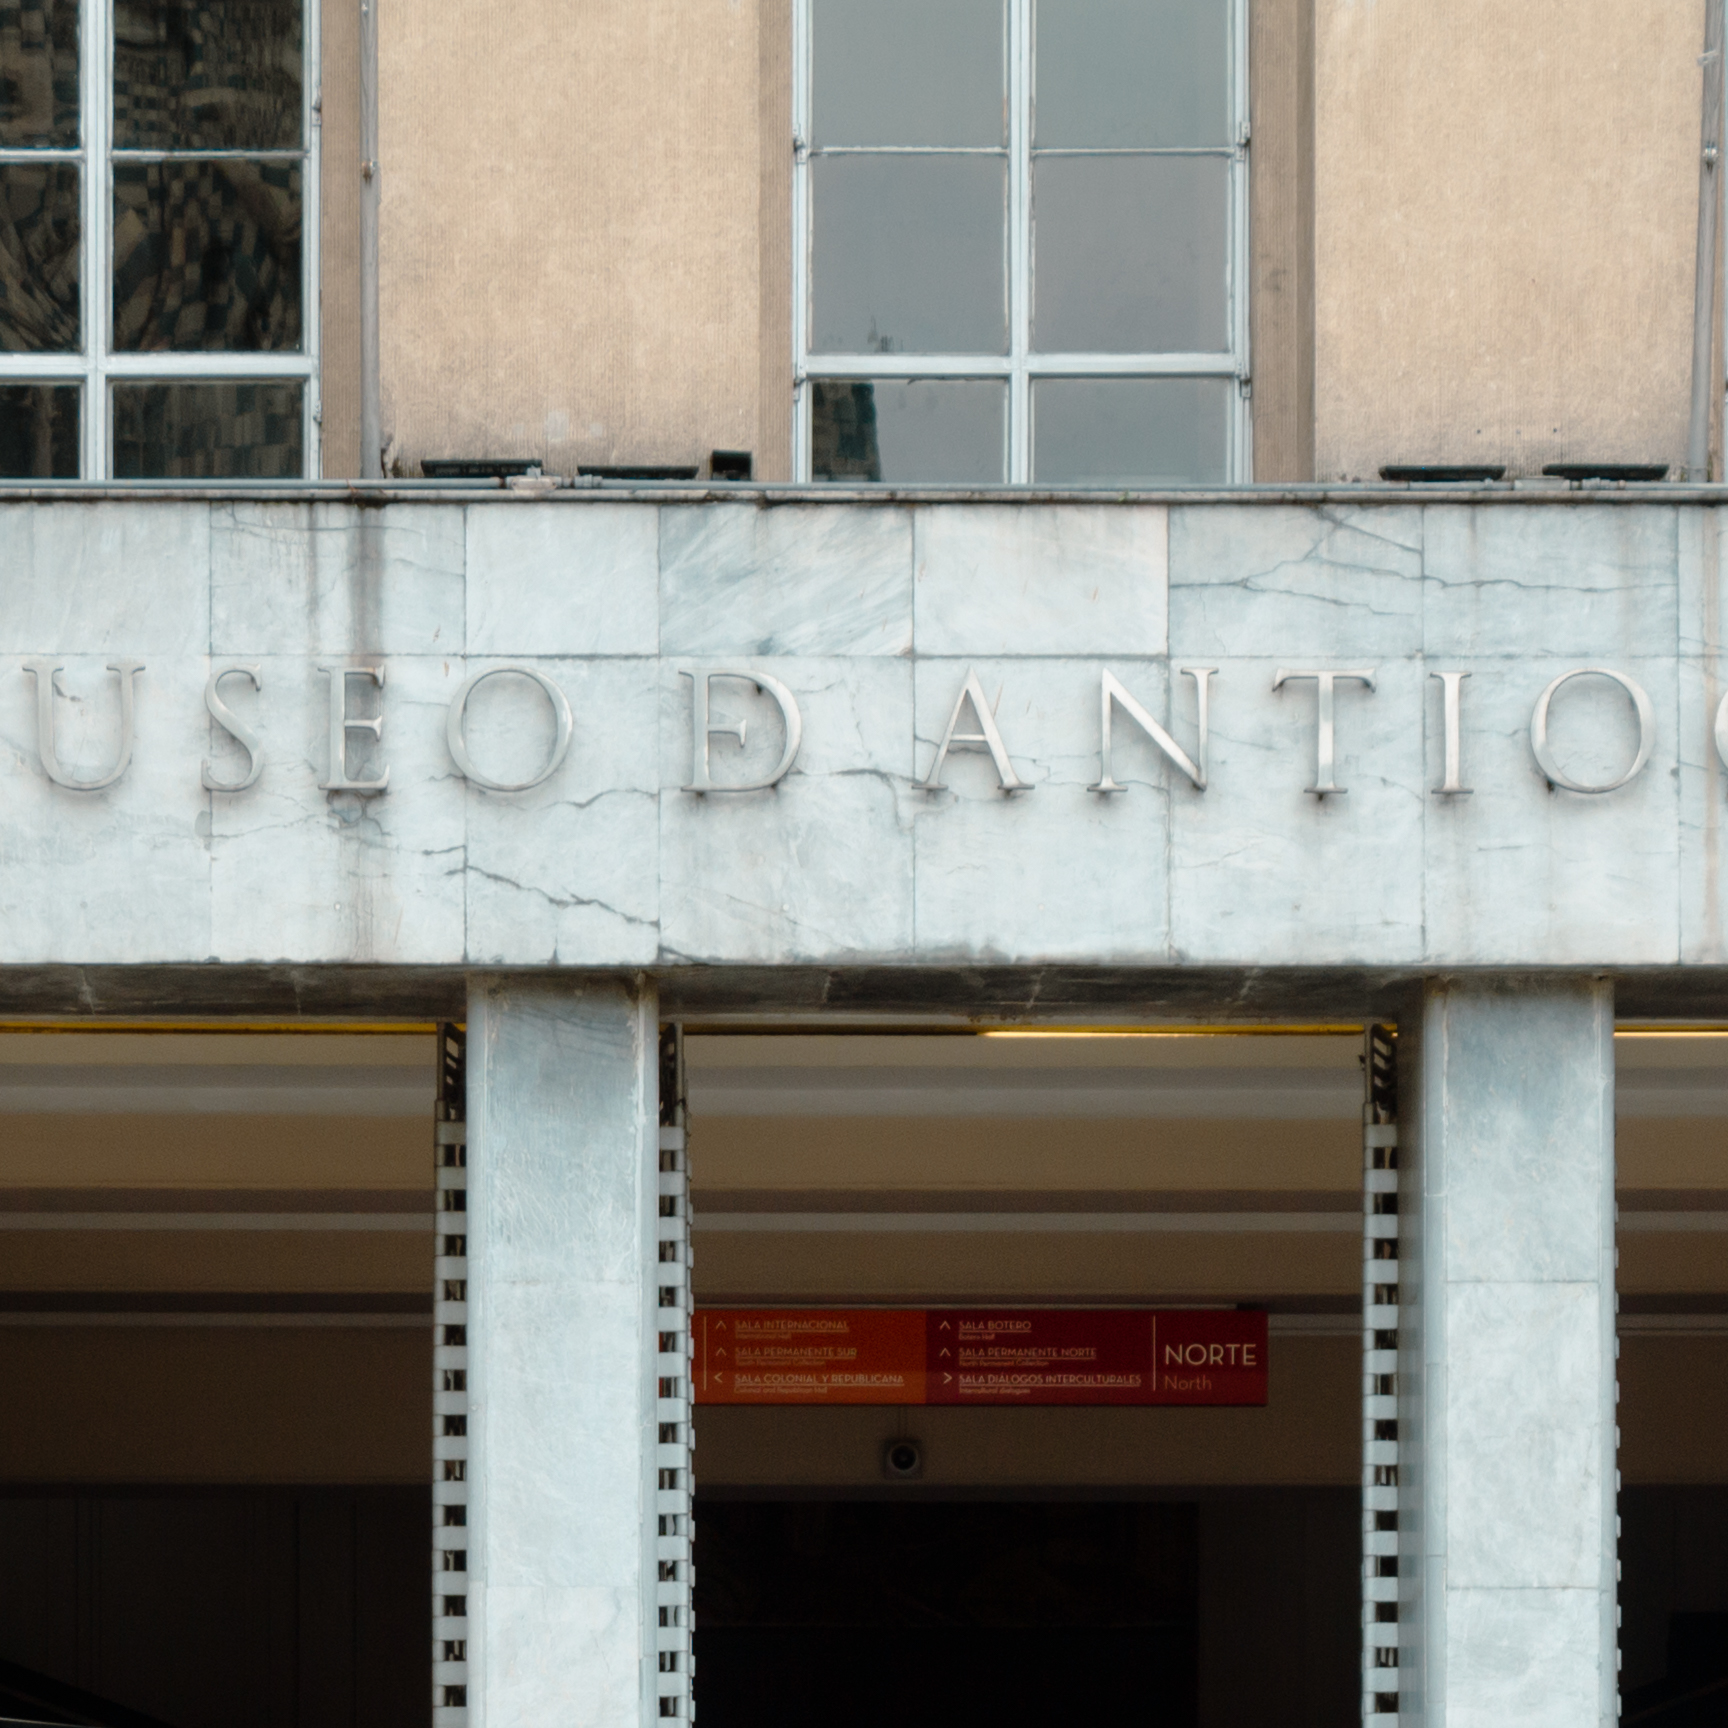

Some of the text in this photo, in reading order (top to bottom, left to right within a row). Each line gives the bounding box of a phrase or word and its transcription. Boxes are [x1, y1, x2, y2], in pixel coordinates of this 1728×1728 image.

[734, 1320, 849, 1330] SALA INTERNACIONAL
[959, 1320, 1032, 1330] SALA BOTERO
[734, 1347, 761, 1356] SALA
[763, 1347, 834, 1356] PERMANENTE
[959, 1347, 1097, 1358] SALA PERMANENTE NORTE
[1164, 1343, 1257, 1366] NORTE
[734, 1373, 904, 1384] SALA COLONIAL Y REPUBLICANA
[959, 1372, 1142, 1385] SALA DIÁLOGOS INTERCULTURALES
[1164, 1374, 1212, 1391] North
